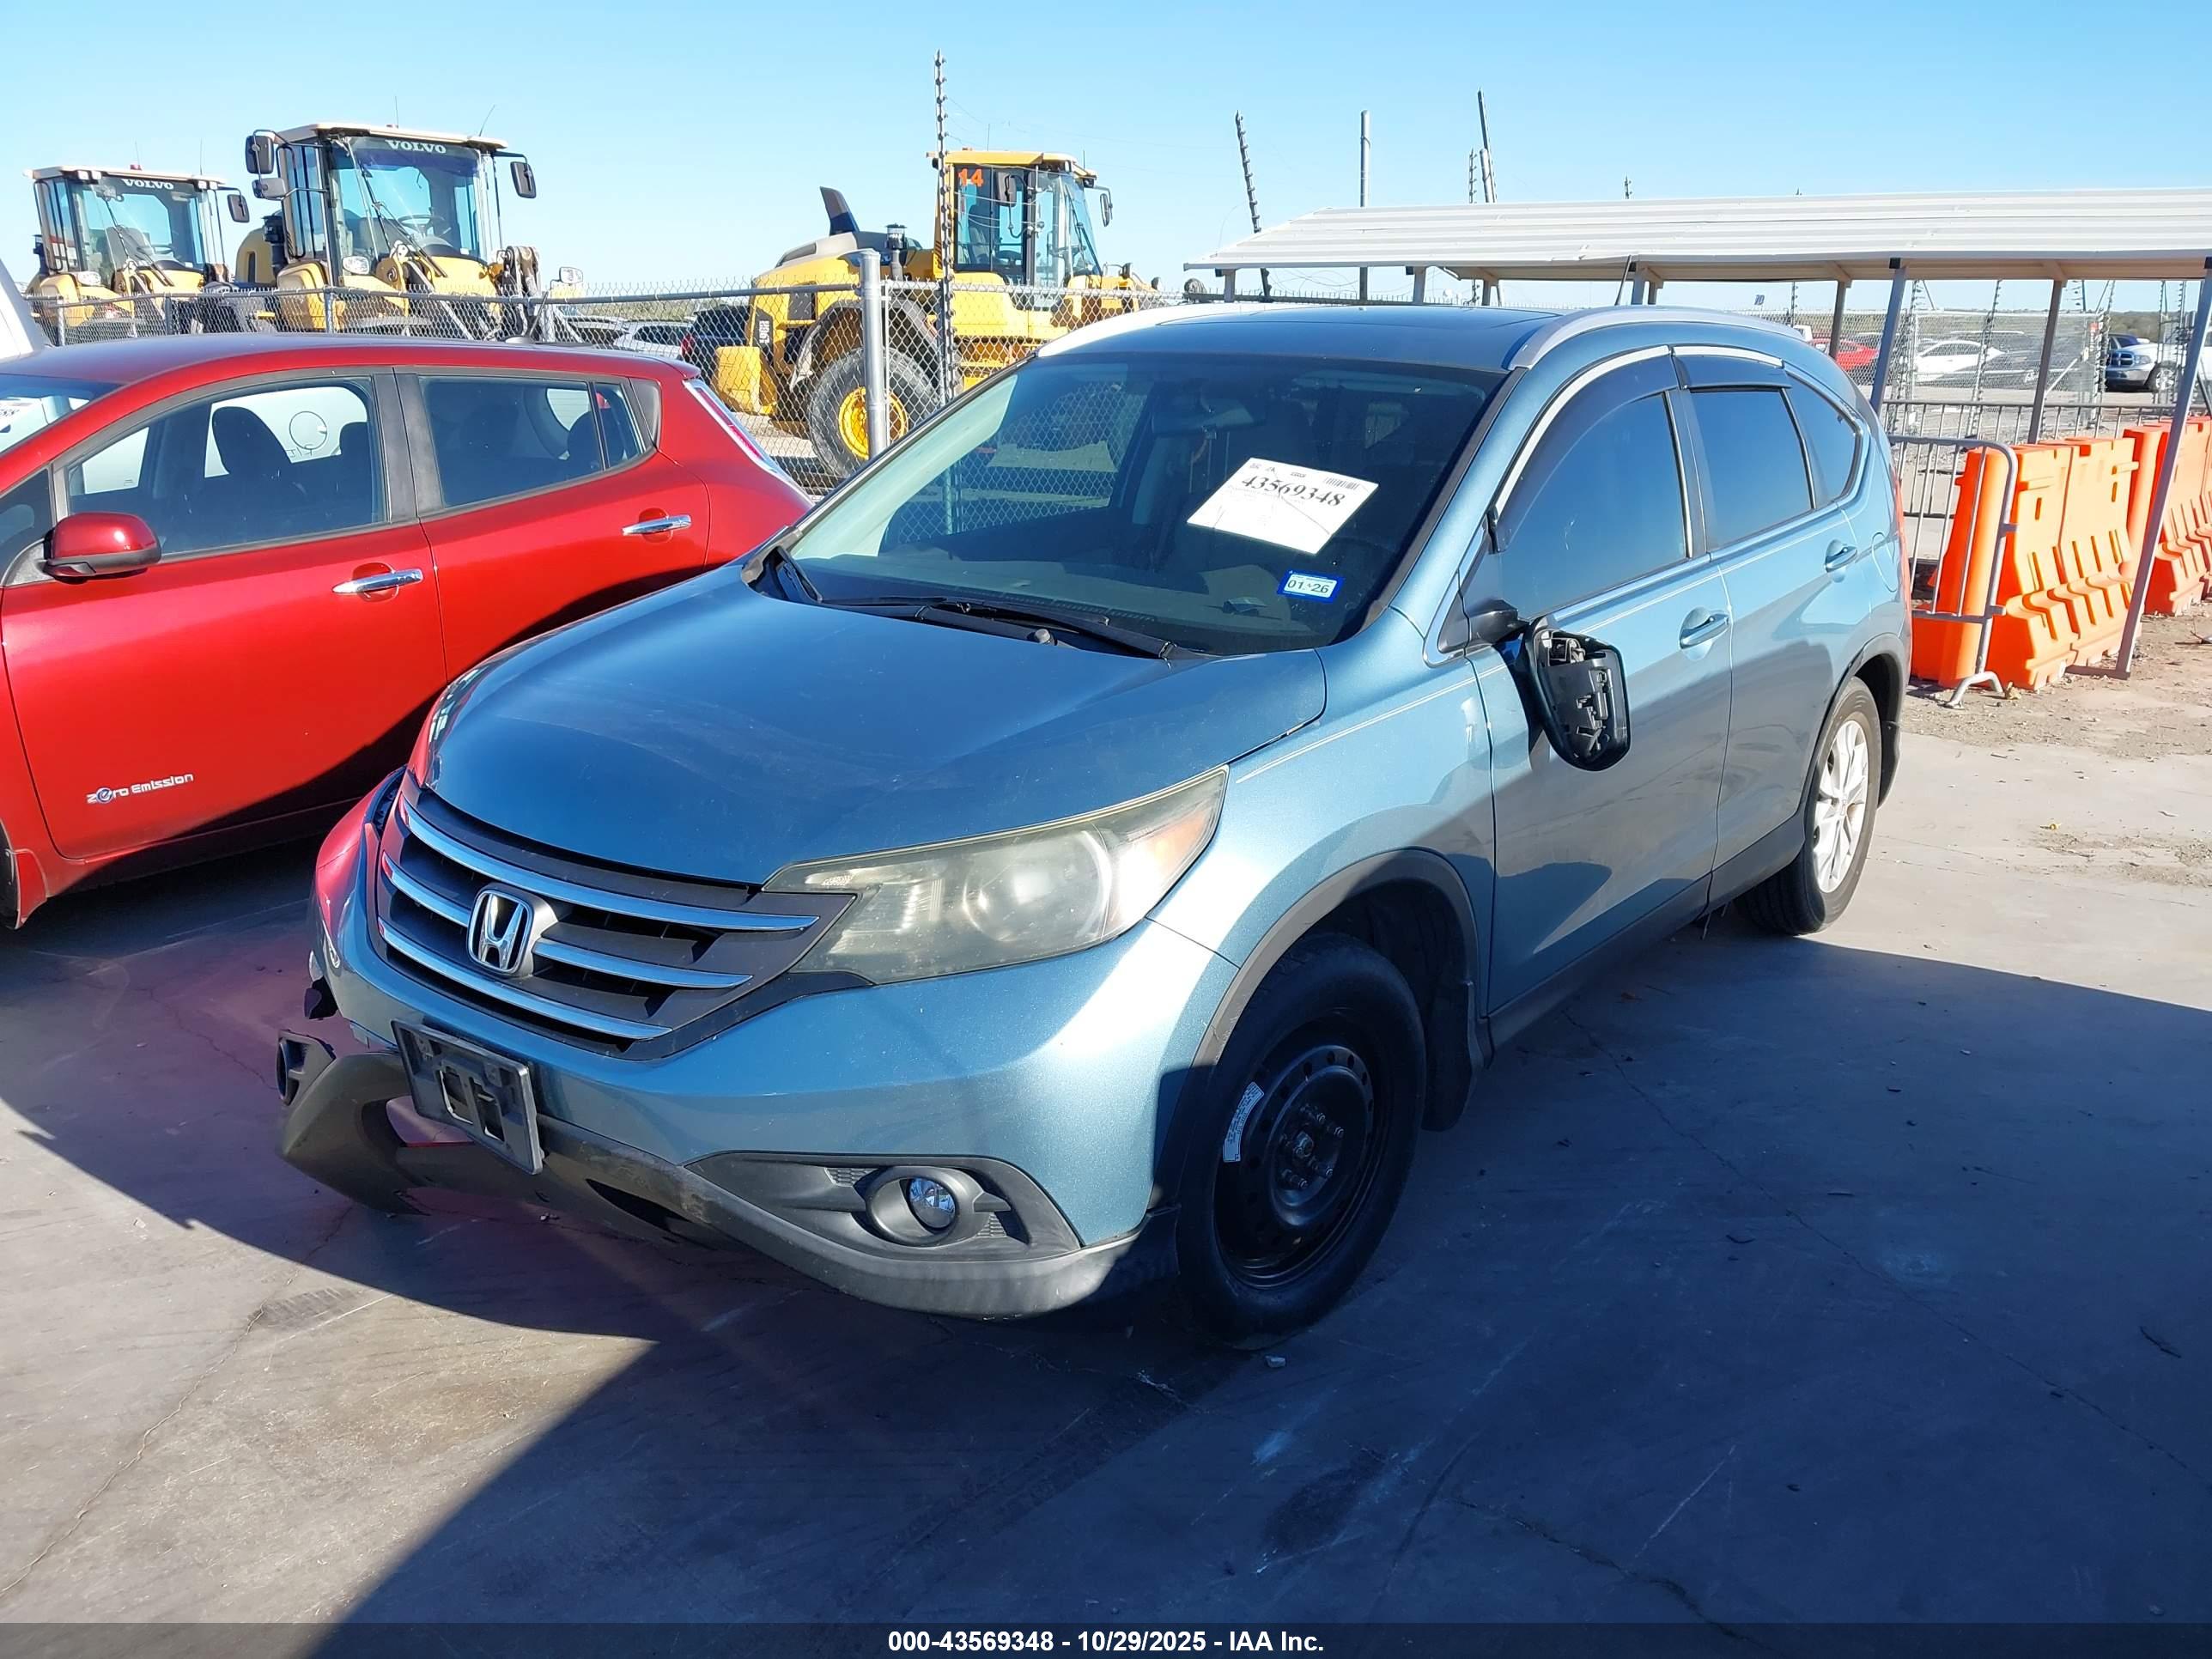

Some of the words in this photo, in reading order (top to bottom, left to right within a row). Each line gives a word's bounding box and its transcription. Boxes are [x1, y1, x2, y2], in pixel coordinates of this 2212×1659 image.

[385, 139, 447, 154] VOLVO
[121, 178, 174, 190] VOLVO
[957, 168, 984, 187] 14
[1242, 475, 1346, 507] 43569348
[1287, 579, 1304, 590] 01
[1310, 583, 1330, 594] 26
[131, 773, 194, 793] Emission
